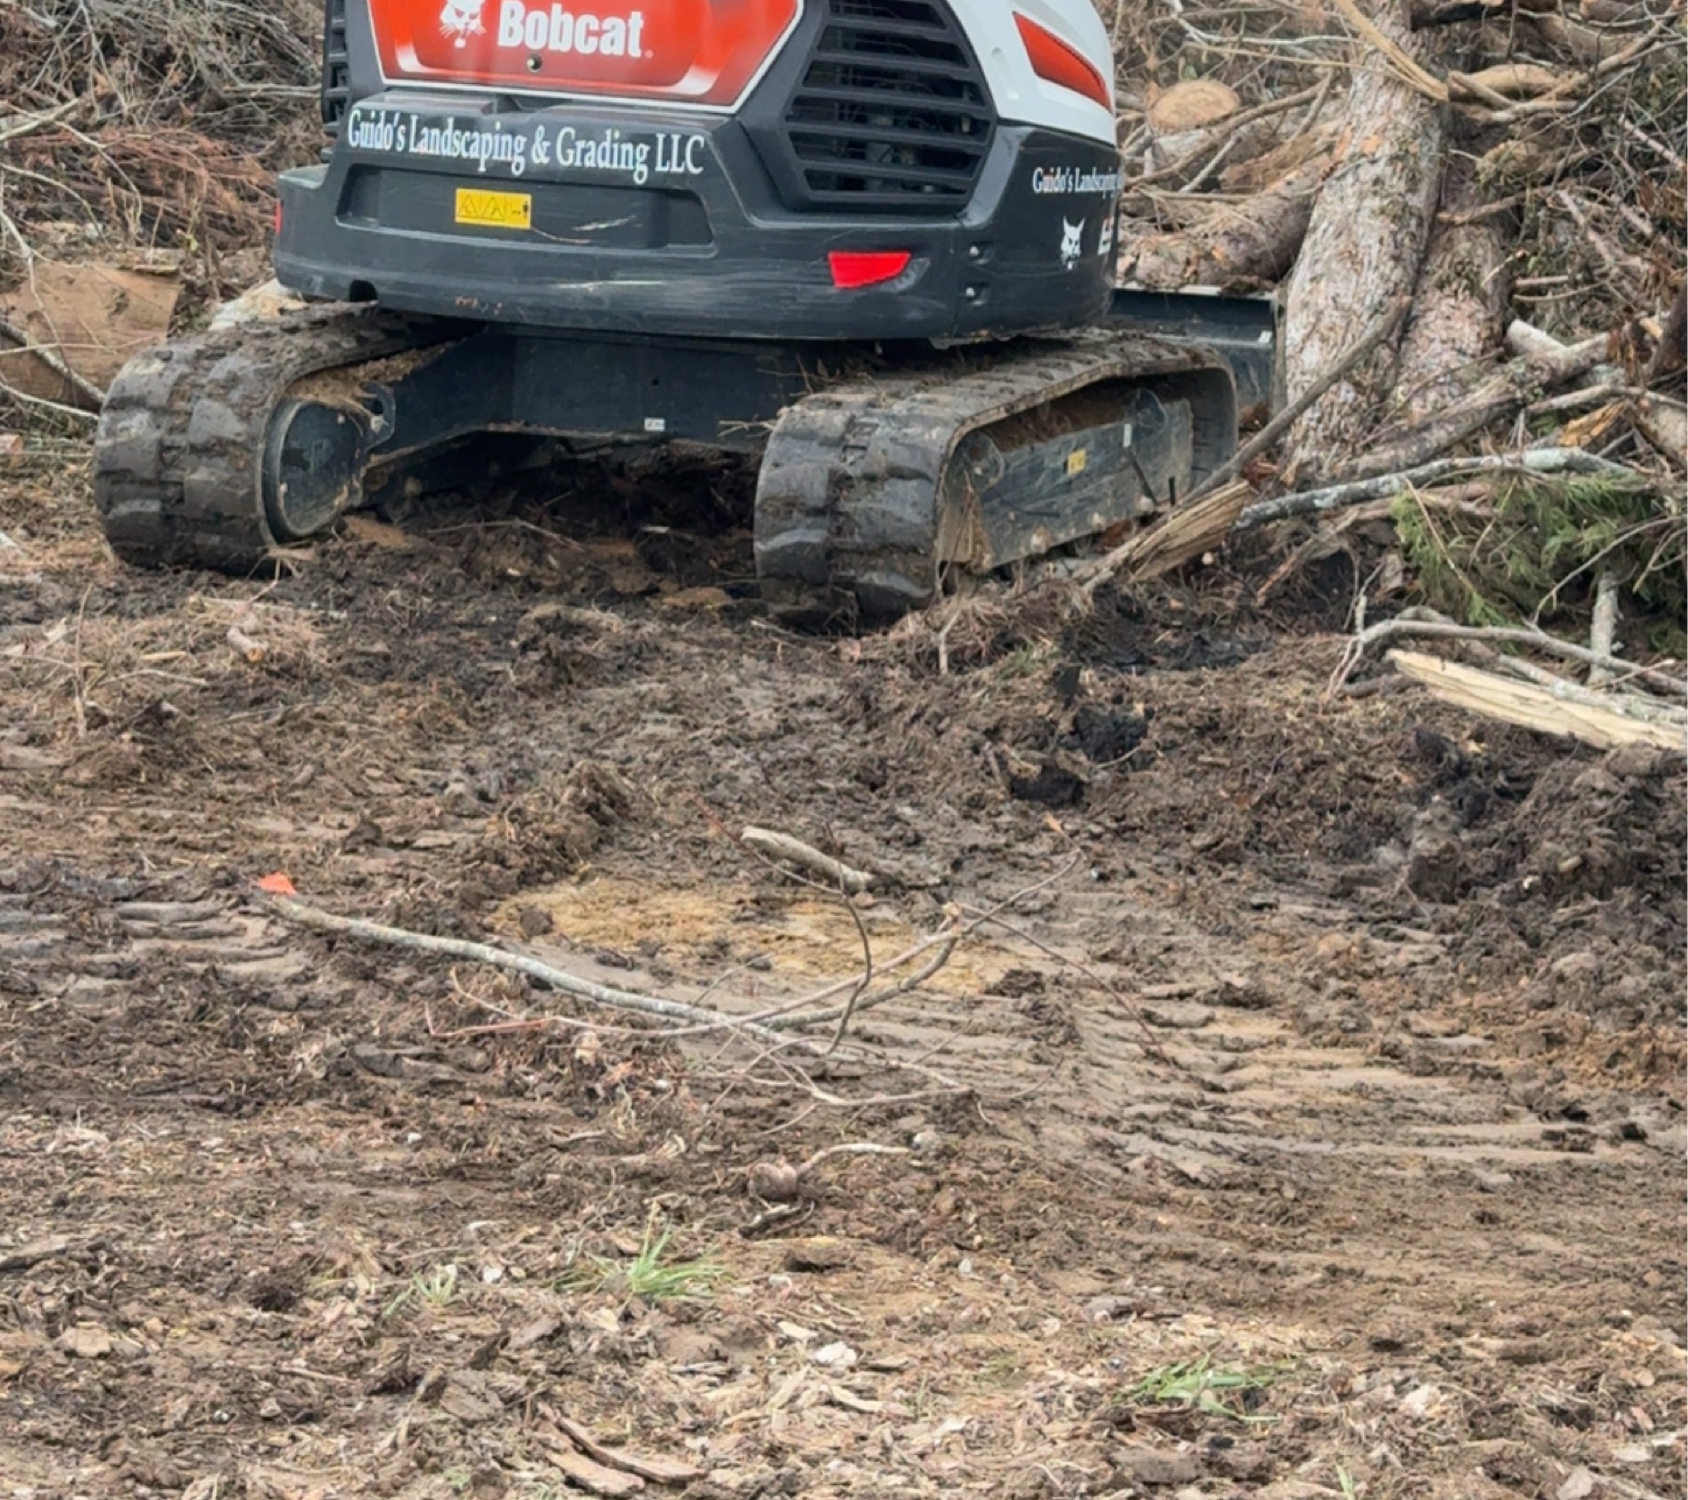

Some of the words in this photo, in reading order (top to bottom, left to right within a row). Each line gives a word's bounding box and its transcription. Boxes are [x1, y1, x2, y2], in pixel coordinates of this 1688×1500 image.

[497, 0, 645, 58] Bobcat
[348, 109, 407, 151] Guido's
[408, 114, 527, 175] Landscaping
[531, 124, 550, 165] &
[555, 126, 652, 184] Grading
[654, 132, 705, 175] LLC
[1032, 166, 1073, 193] Guido's
